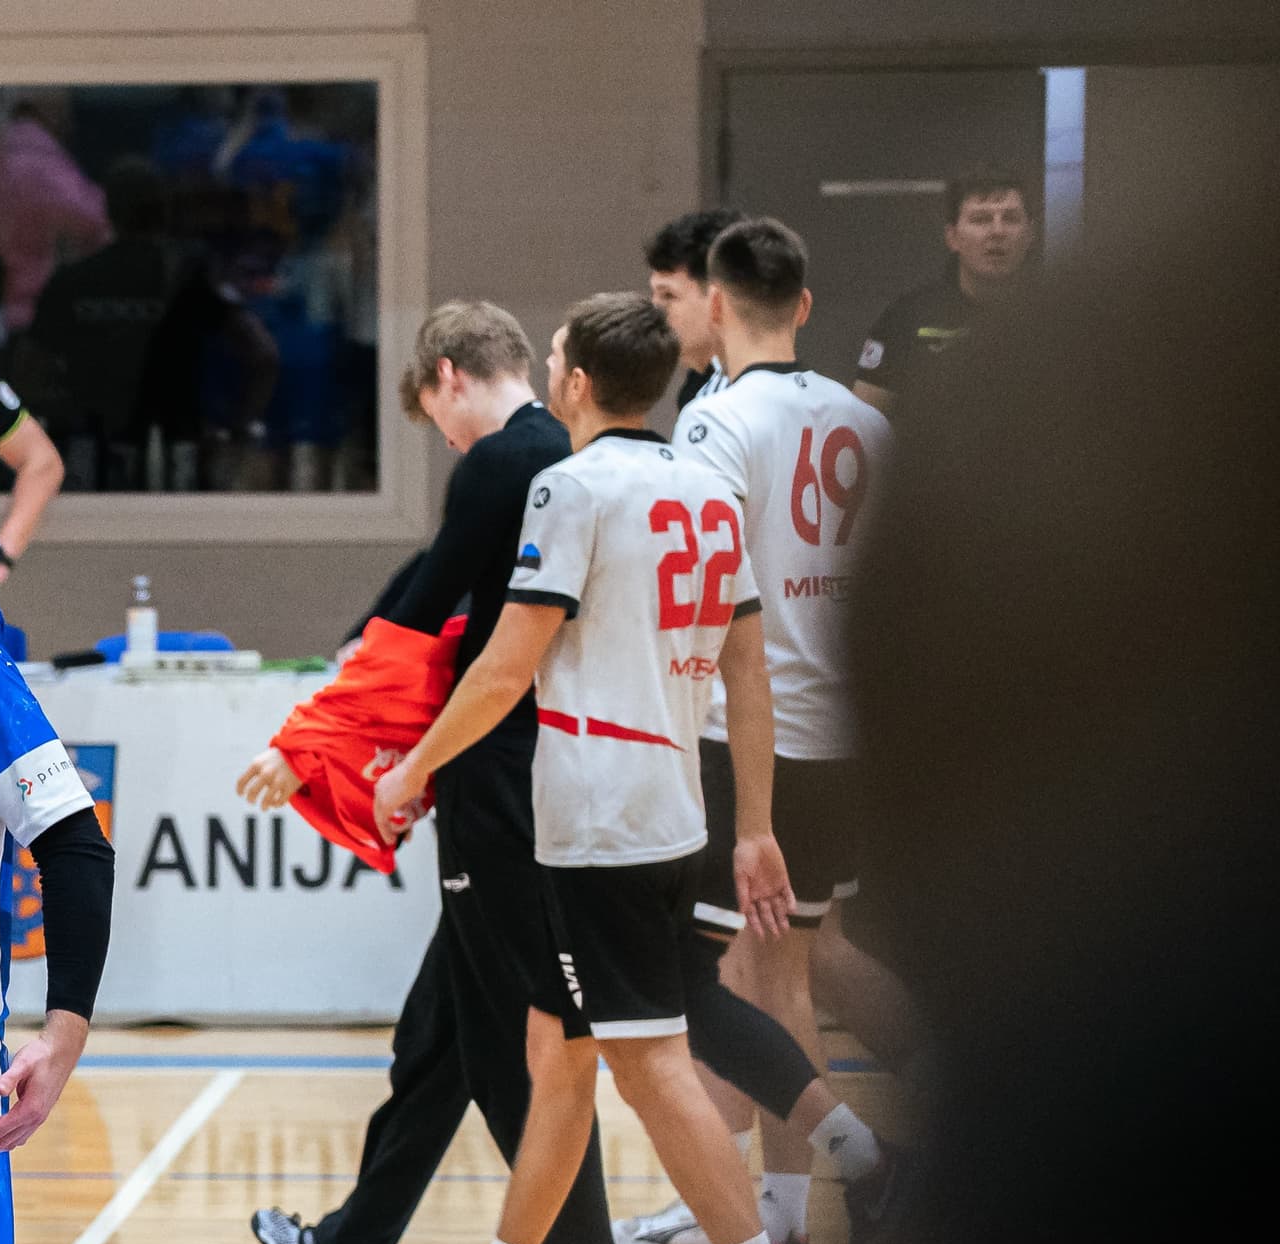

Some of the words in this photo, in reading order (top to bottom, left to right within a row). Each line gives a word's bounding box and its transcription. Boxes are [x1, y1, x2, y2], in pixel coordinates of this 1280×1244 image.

[791, 425, 866, 546] 69
[649, 499, 741, 631] 22
[37, 759, 76, 785] prim
